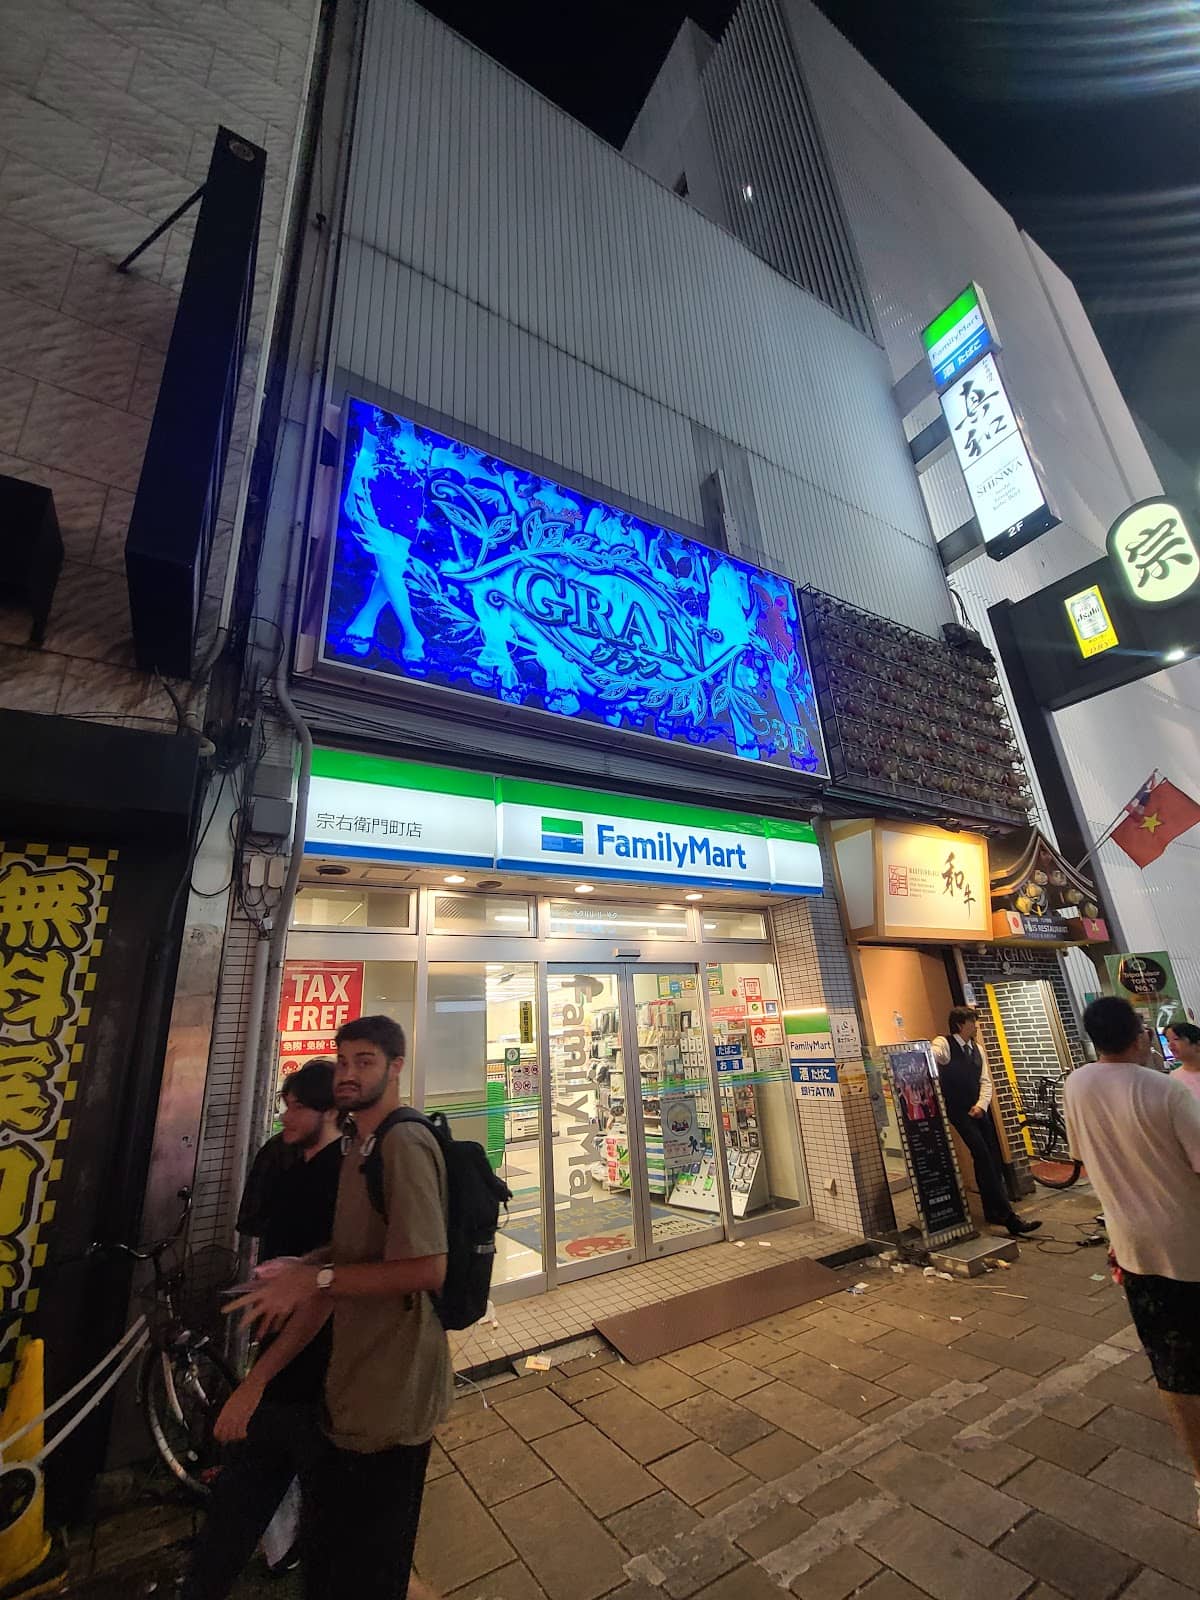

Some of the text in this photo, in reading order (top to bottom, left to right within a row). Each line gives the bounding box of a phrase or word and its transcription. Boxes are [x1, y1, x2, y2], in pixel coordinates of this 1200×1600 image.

[975, 459, 1023, 497] SHINWA
[1007, 520, 1024, 538] 2F
[512, 565, 706, 672] GRAN
[1077, 607, 1100, 623] Asahi
[592, 643, 661, 680] グラン
[771, 717, 809, 755] 3F
[316, 812, 423, 839] 宗右衛門町店
[597, 823, 747, 870] FamilyMart
[292, 974, 351, 1003] TAX
[286, 1005, 349, 1031] FREE
[718, 1046, 738, 1056] たばこ
[790, 1040, 832, 1053] FamilyMart
[811, 1067, 831, 1080] たばこ
[801, 1085, 835, 1098] 銀行ATM
